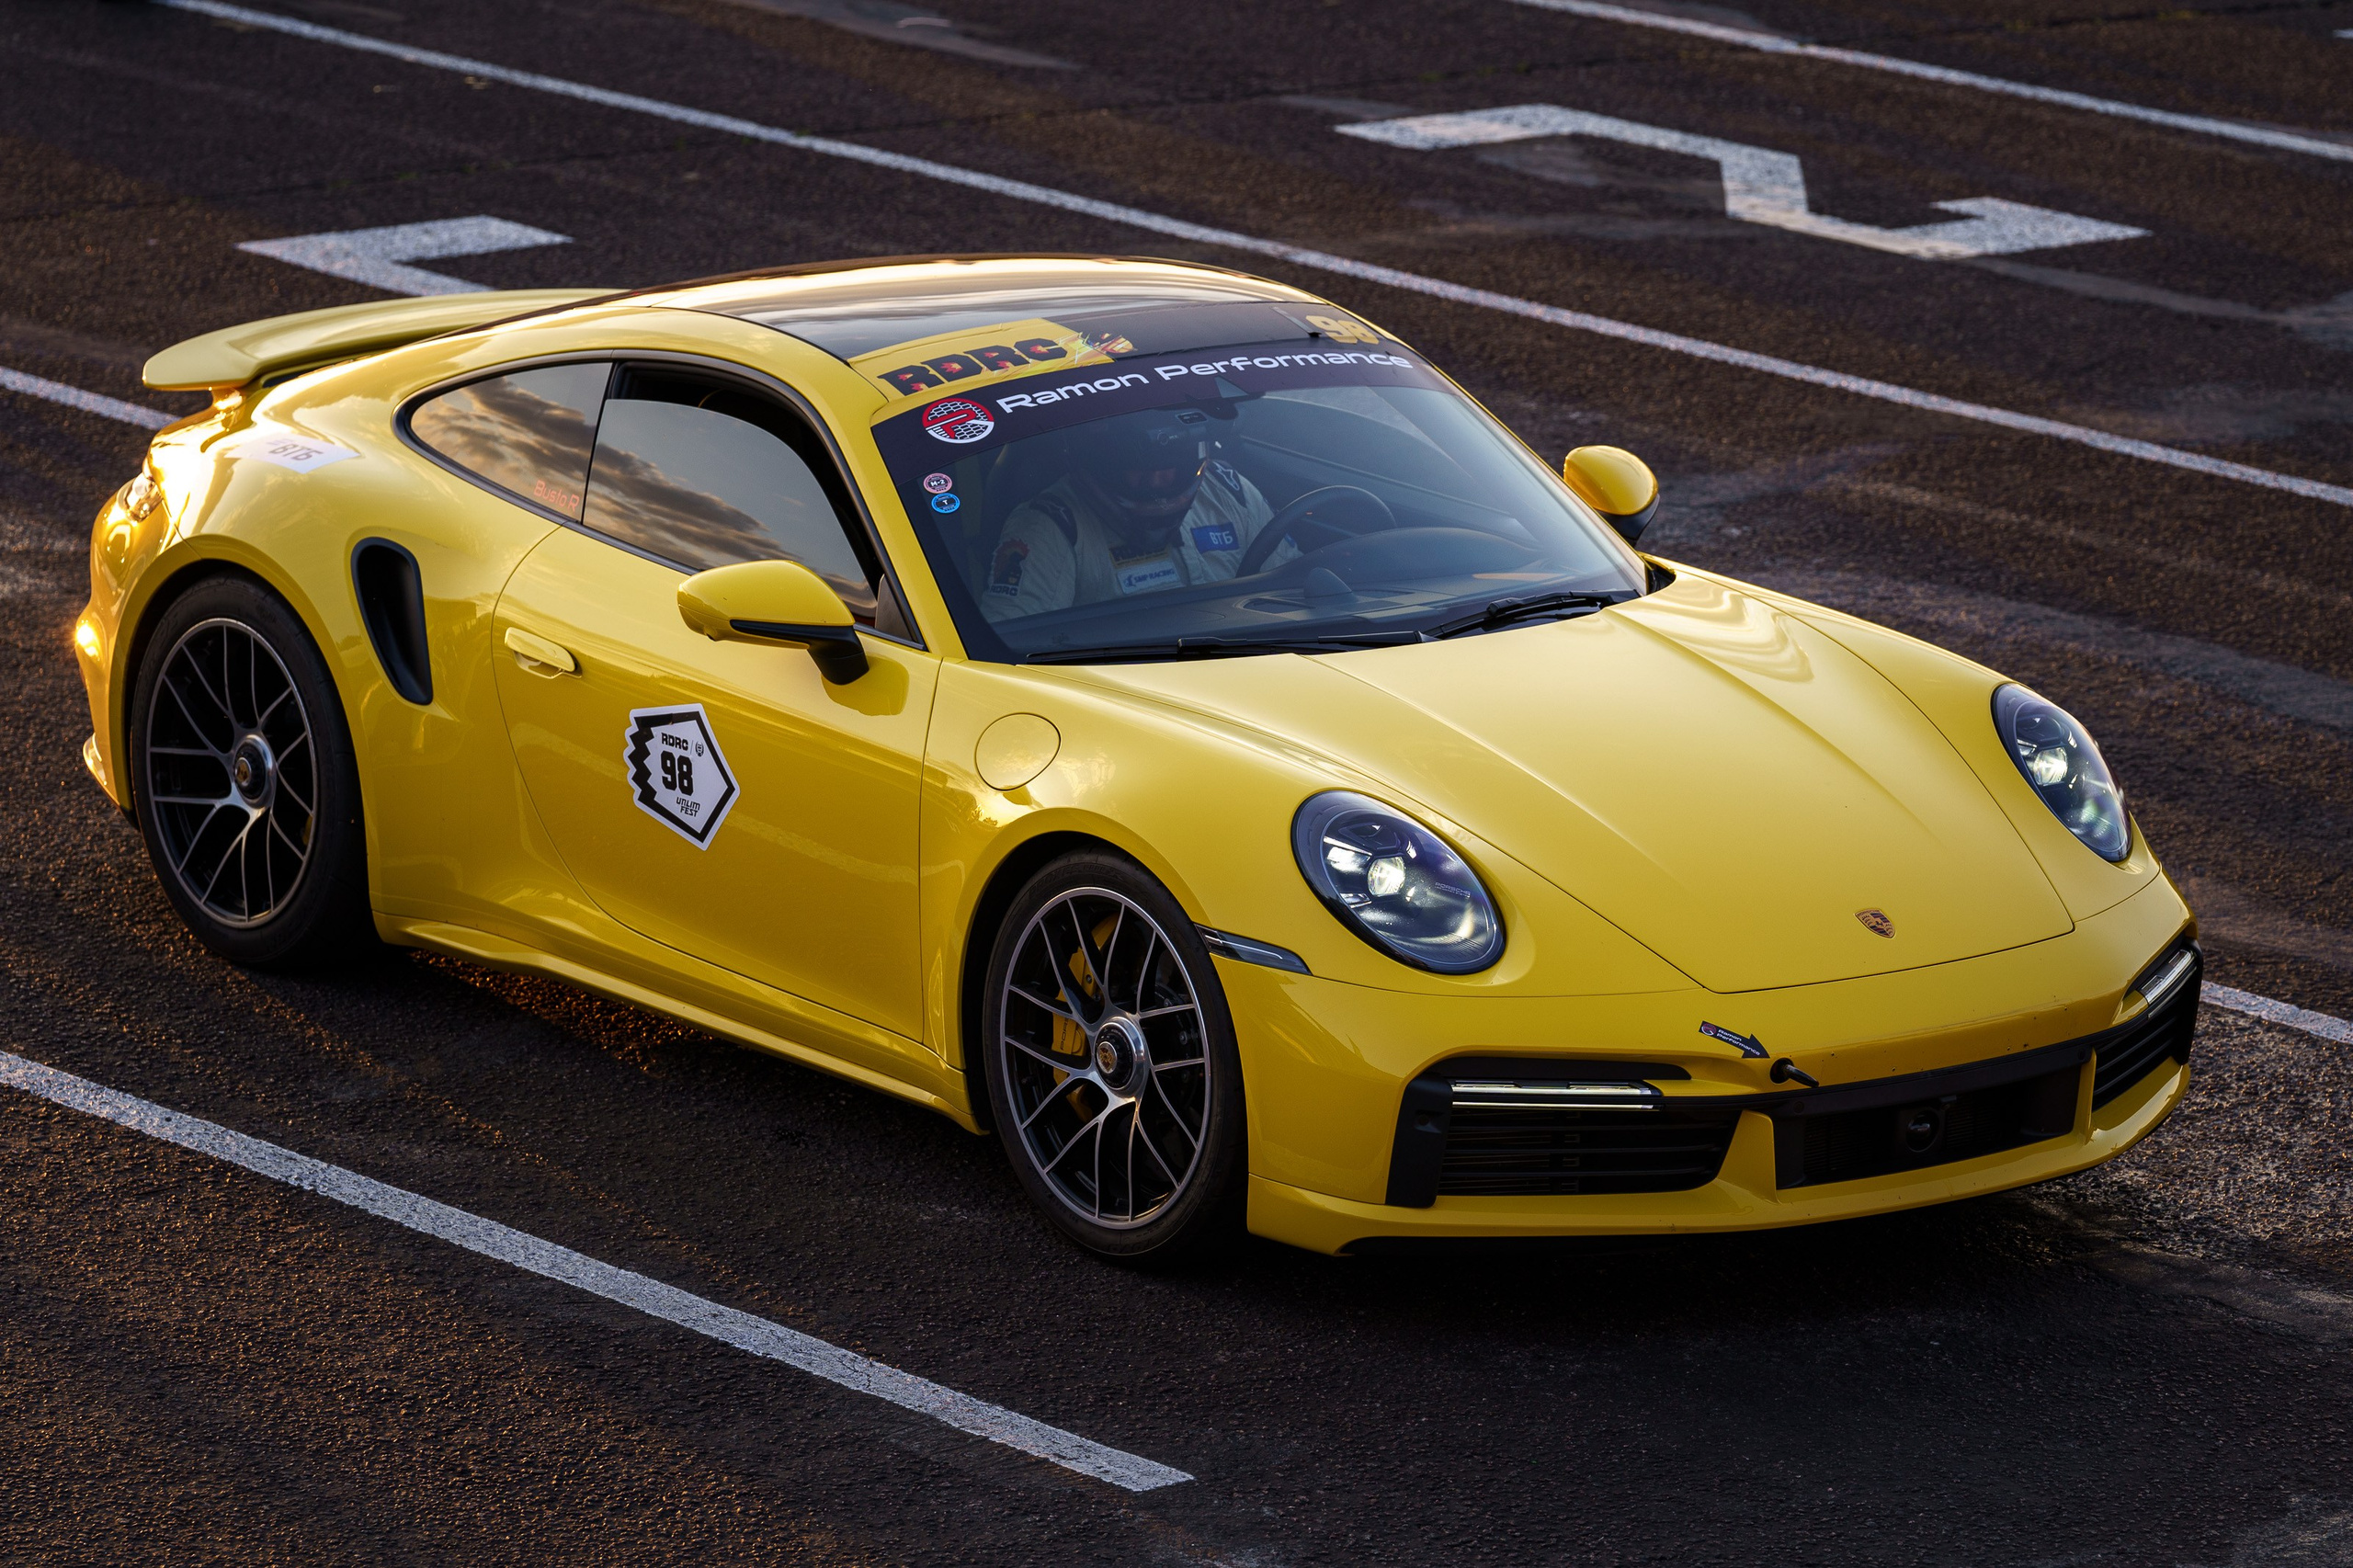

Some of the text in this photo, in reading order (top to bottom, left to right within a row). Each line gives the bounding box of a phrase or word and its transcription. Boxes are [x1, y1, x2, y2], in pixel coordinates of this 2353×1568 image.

[1306, 315, 1379, 345] 98
[877, 337, 1067, 396] RDRC
[996, 350, 1414, 414] Ramon Performance
[268, 443, 324, 460] ВТБ
[1209, 530, 1233, 545] ВТБ
[661, 732, 689, 752] RDRC
[661, 750, 694, 796] 98
[680, 806, 699, 818] FEST
[1715, 1032, 1761, 1056] Performance
[1717, 1028, 1742, 1041] Ramon
